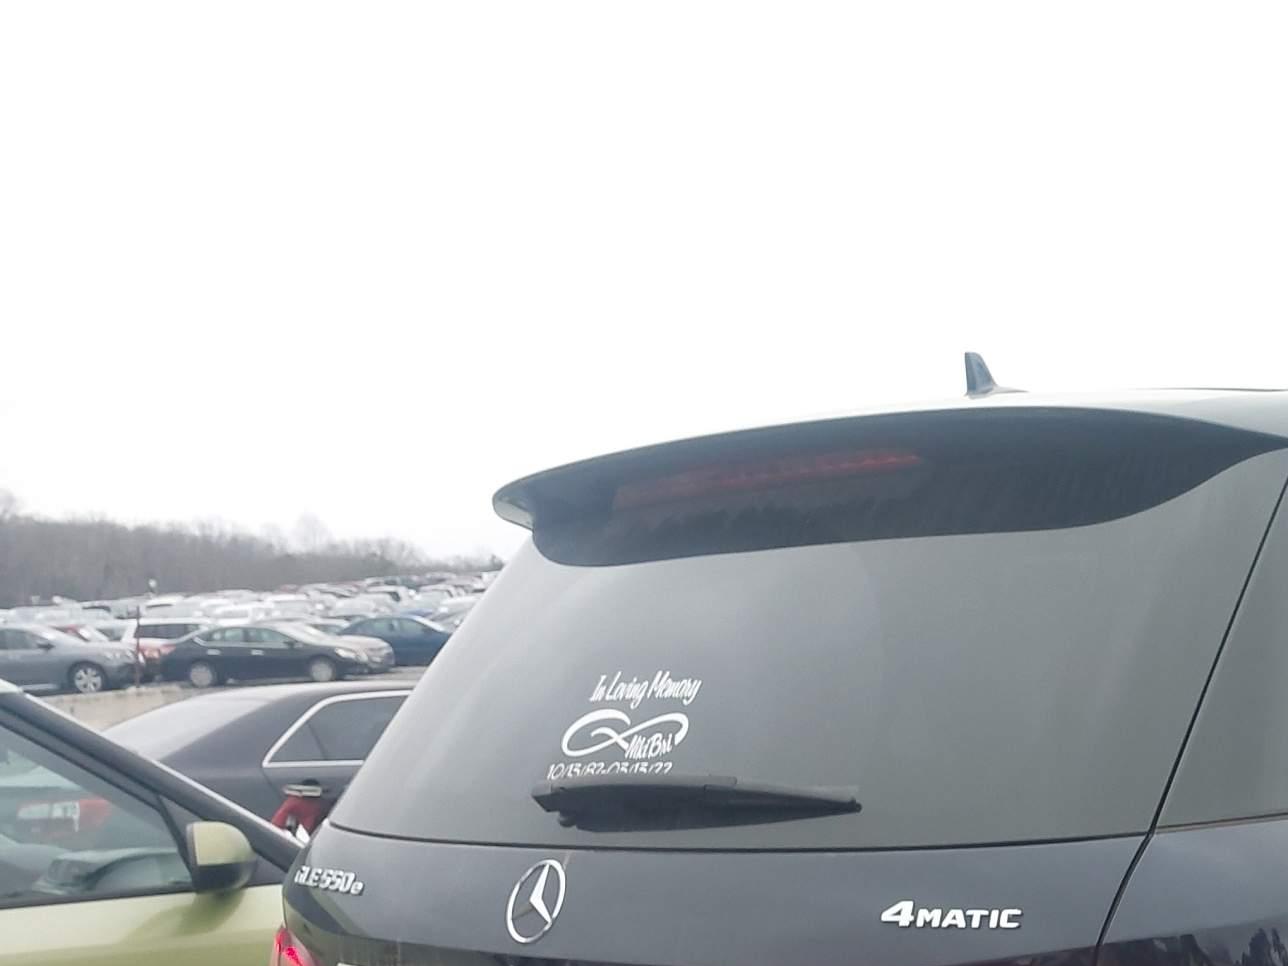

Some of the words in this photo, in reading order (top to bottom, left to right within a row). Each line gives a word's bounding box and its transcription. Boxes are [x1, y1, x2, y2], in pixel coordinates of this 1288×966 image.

[589, 675, 606, 702] In
[605, 671, 649, 709] Loving
[646, 670, 702, 705] Memory
[880, 900, 1022, 929] 4MATIC
